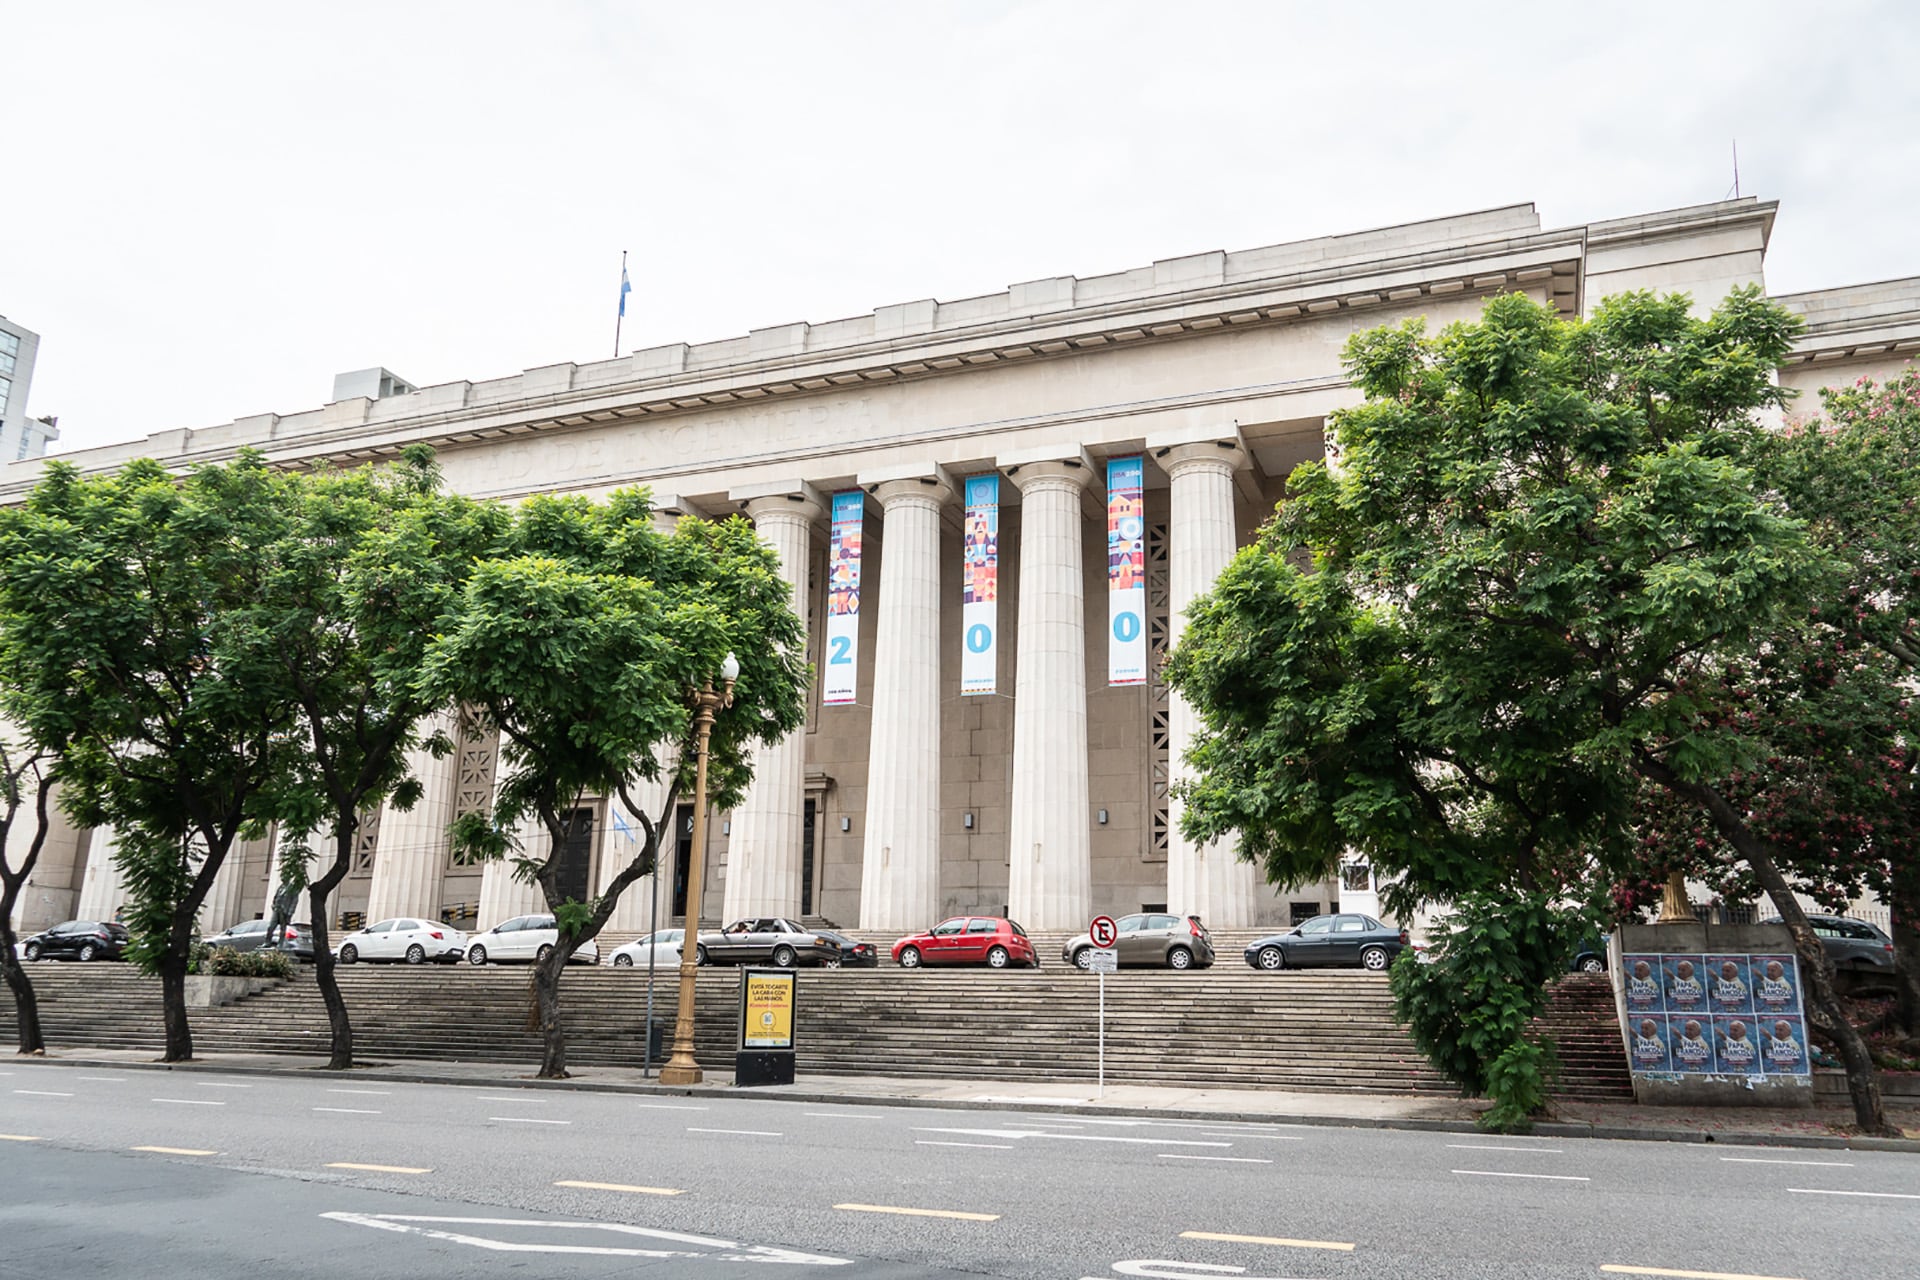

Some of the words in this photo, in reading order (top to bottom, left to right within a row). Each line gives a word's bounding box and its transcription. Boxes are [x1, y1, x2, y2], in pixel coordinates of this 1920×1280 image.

[966, 623, 992, 653] 0
[1113, 611, 1140, 642] 0
[830, 636, 852, 664] 2
